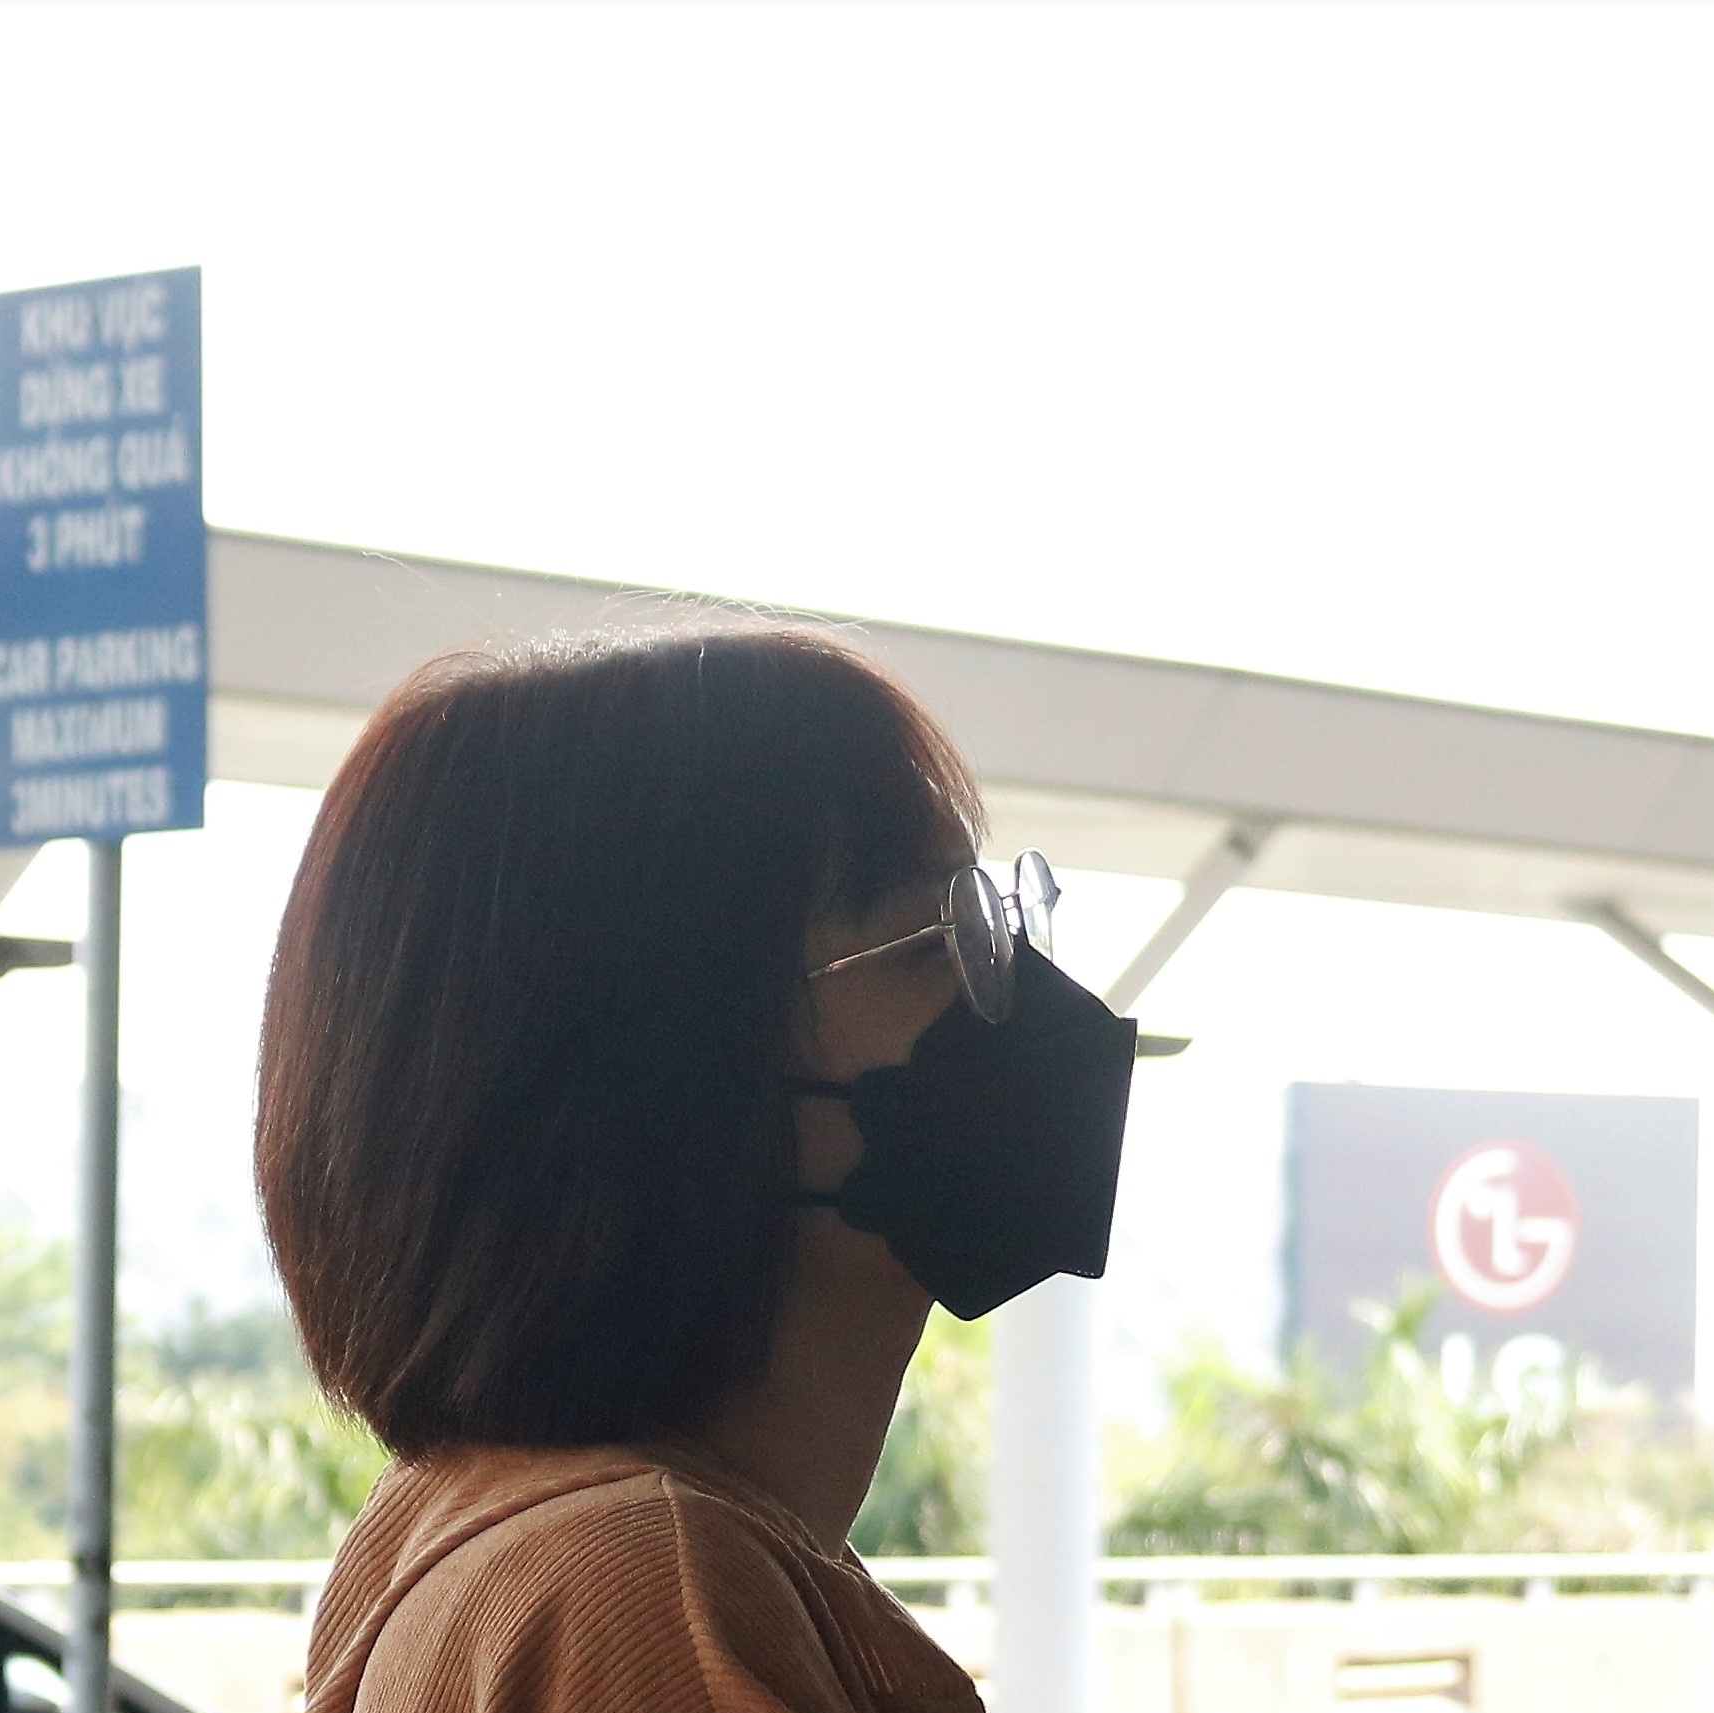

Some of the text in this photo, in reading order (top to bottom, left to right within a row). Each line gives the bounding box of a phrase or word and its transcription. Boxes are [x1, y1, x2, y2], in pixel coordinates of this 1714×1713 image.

[21, 297, 92, 355] KHU
[121, 355, 165, 415] XE
[27, 515, 47, 573] 3
[57, 624, 199, 692] PARKING
